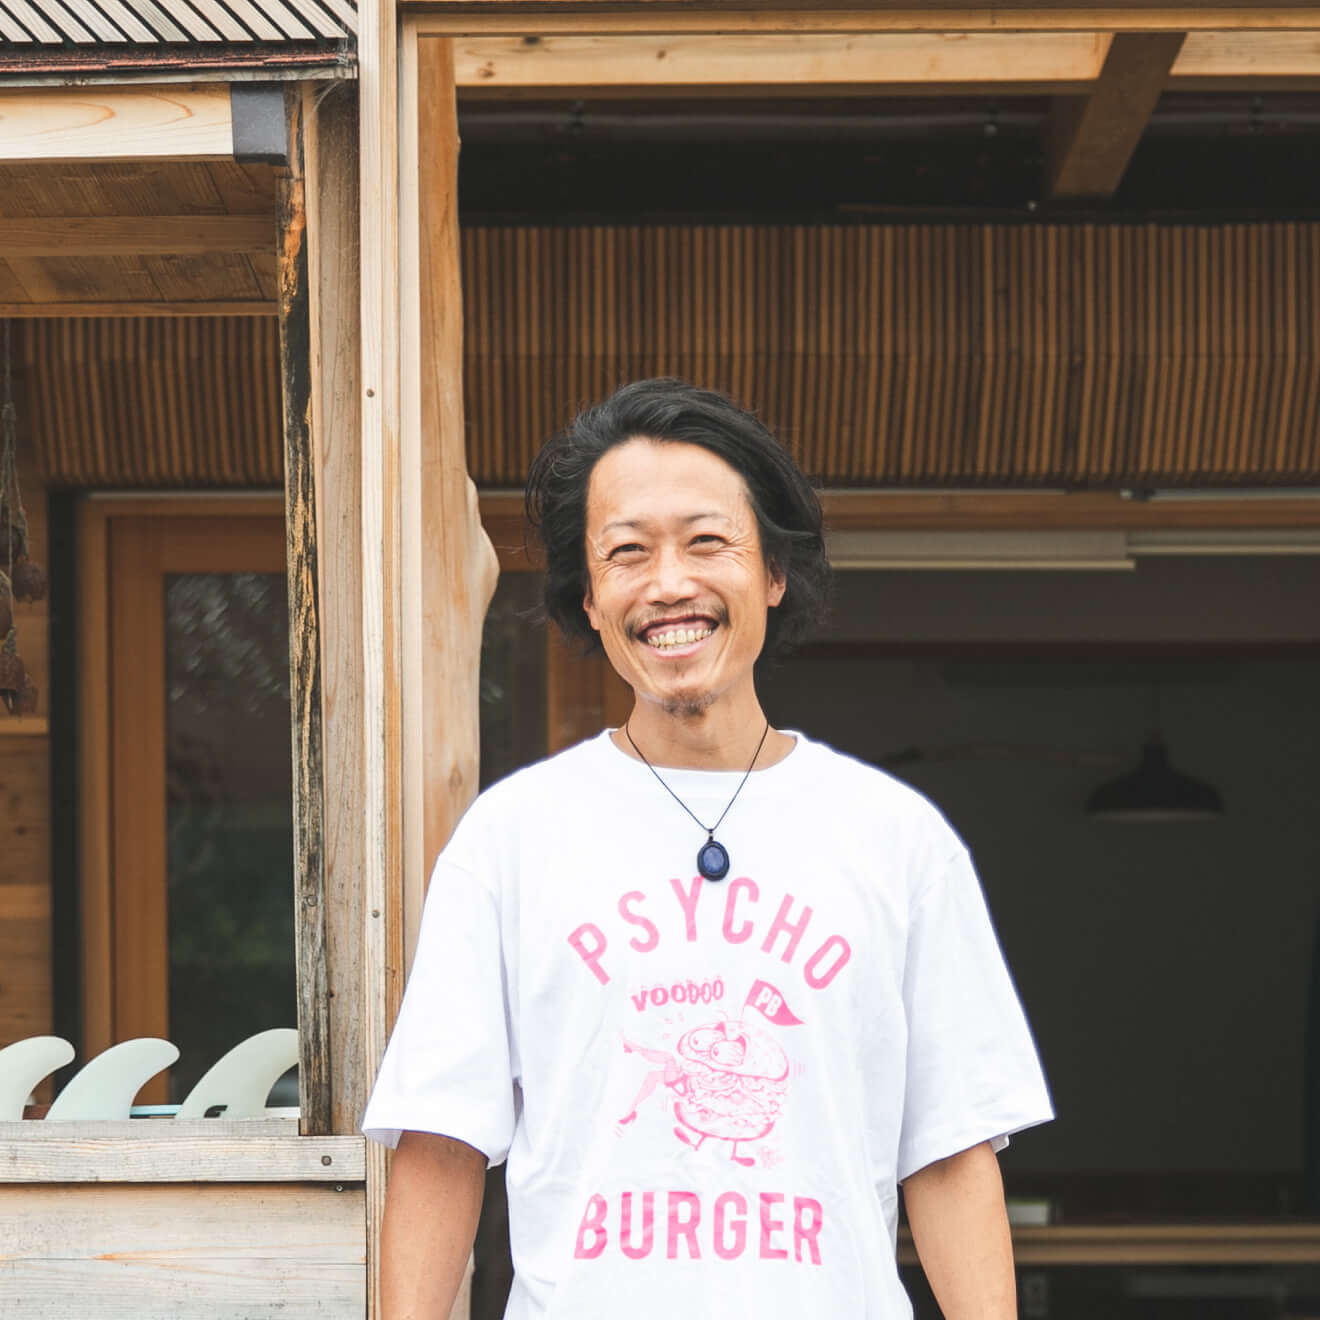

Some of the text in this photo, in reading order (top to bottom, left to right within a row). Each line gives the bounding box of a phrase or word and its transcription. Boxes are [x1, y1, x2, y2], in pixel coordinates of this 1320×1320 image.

[567, 876, 852, 990] PSYCHO
[631, 978, 725, 1013] VOODOO
[754, 985, 782, 1017] PB
[574, 1191, 823, 1266] BURGER
